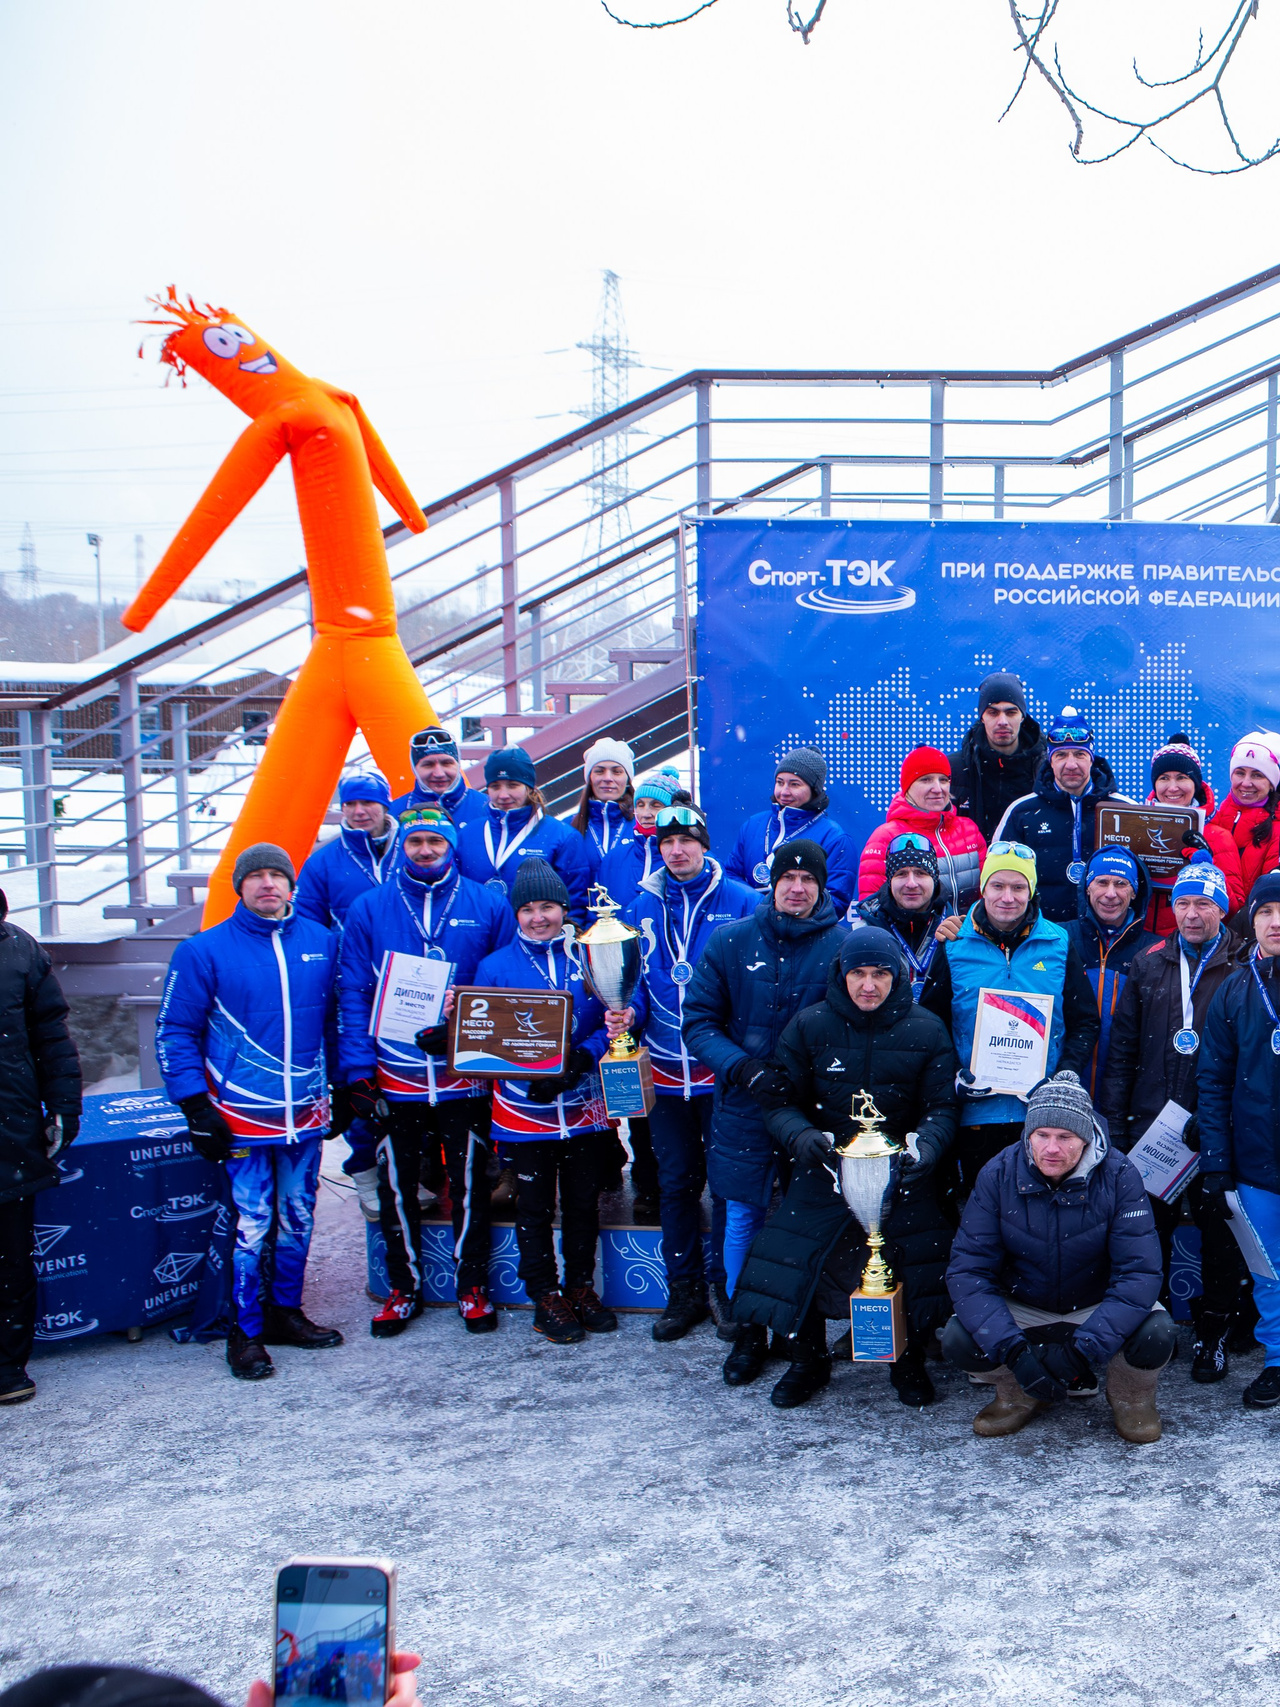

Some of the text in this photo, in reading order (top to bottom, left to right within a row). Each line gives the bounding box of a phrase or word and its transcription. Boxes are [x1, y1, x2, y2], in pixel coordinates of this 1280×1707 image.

[749, 559, 896, 587] Спорт-ТЭК
[941, 562, 985, 579] ПРИ
[994, 562, 1134, 581] ПОДДЕРЖКЕ
[994, 585, 1280, 609] РОССИЙСКОЙ ФЕДЕРАЦИИ
[1113, 814, 1120, 833] 1
[1104, 834, 1131, 843] МЕСТО
[394, 987, 435, 1002] ДИПЛОМ
[469, 998, 489, 1018] 2
[462, 1019, 495, 1028] МЕСТО
[989, 1036, 1034, 1050] ДИПЛОМ
[611, 1067, 637, 1075] МЕСТО
[1142, 1144, 1180, 1168] ДИПЛОМ
[1156, 1141, 1174, 1154] место
[130, 1192, 206, 1219] Спорт-ТЭК
[860, 1305, 889, 1313] МЕСТО
